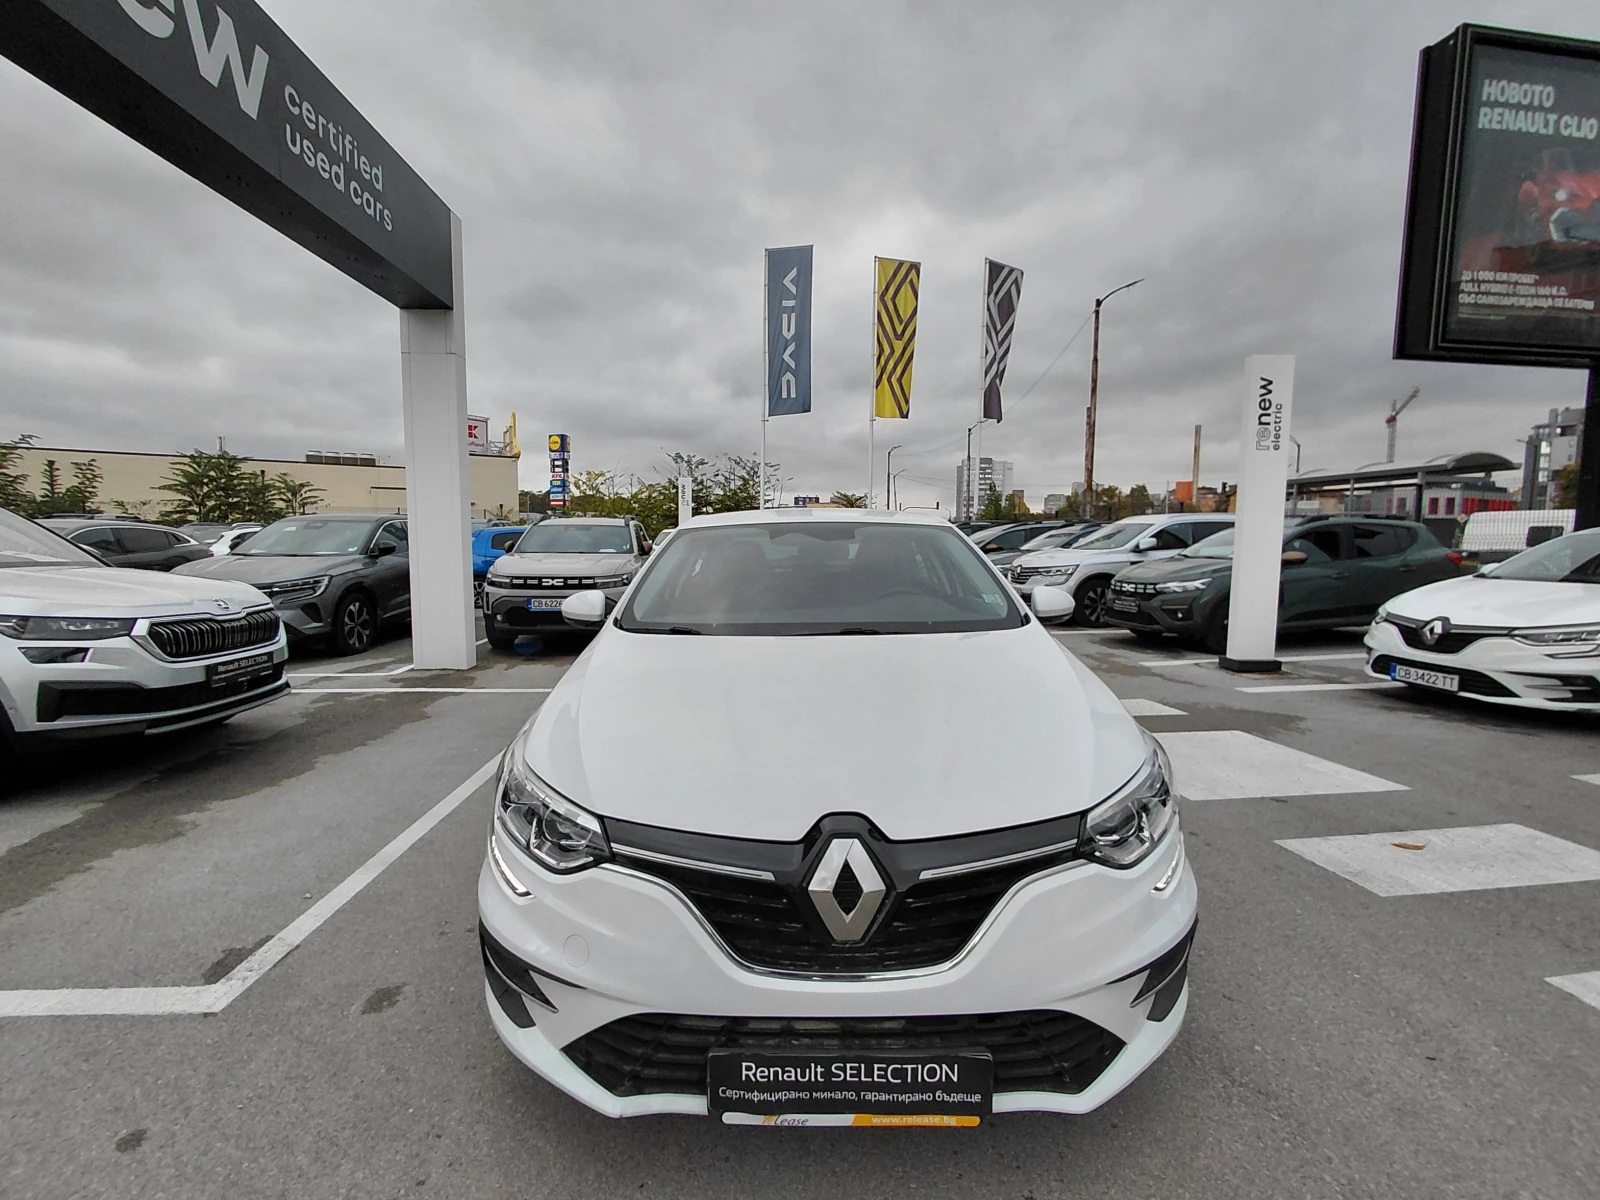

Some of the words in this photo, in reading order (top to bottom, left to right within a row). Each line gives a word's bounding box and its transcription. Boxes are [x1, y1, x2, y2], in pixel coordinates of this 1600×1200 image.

[1481, 79, 1555, 108] НОВОТО
[284, 85, 383, 192] certified
[1478, 107, 1558, 135] RENAULT
[1560, 115, 1598, 140] CLIO
[284, 123, 345, 193] used
[349, 180, 393, 232] cars
[781, 266, 797, 399] DACIA
[1256, 376, 1274, 451] renew
[1271, 402, 1283, 451] electric
[1397, 667, 1411, 680] CB
[1412, 670, 1439, 686] 3422
[1441, 675, 1456, 689] TT
[741, 1061, 825, 1083] Renault
[830, 1063, 959, 1084] SELECTION
[718, 1086, 810, 1104] Сертифицирано
[812, 1090, 858, 1102] минало,
[860, 1090, 933, 1105] гарантирано
[935, 1089, 982, 1103] бъдеще
[871, 1115, 957, 1126] www.release.bg
